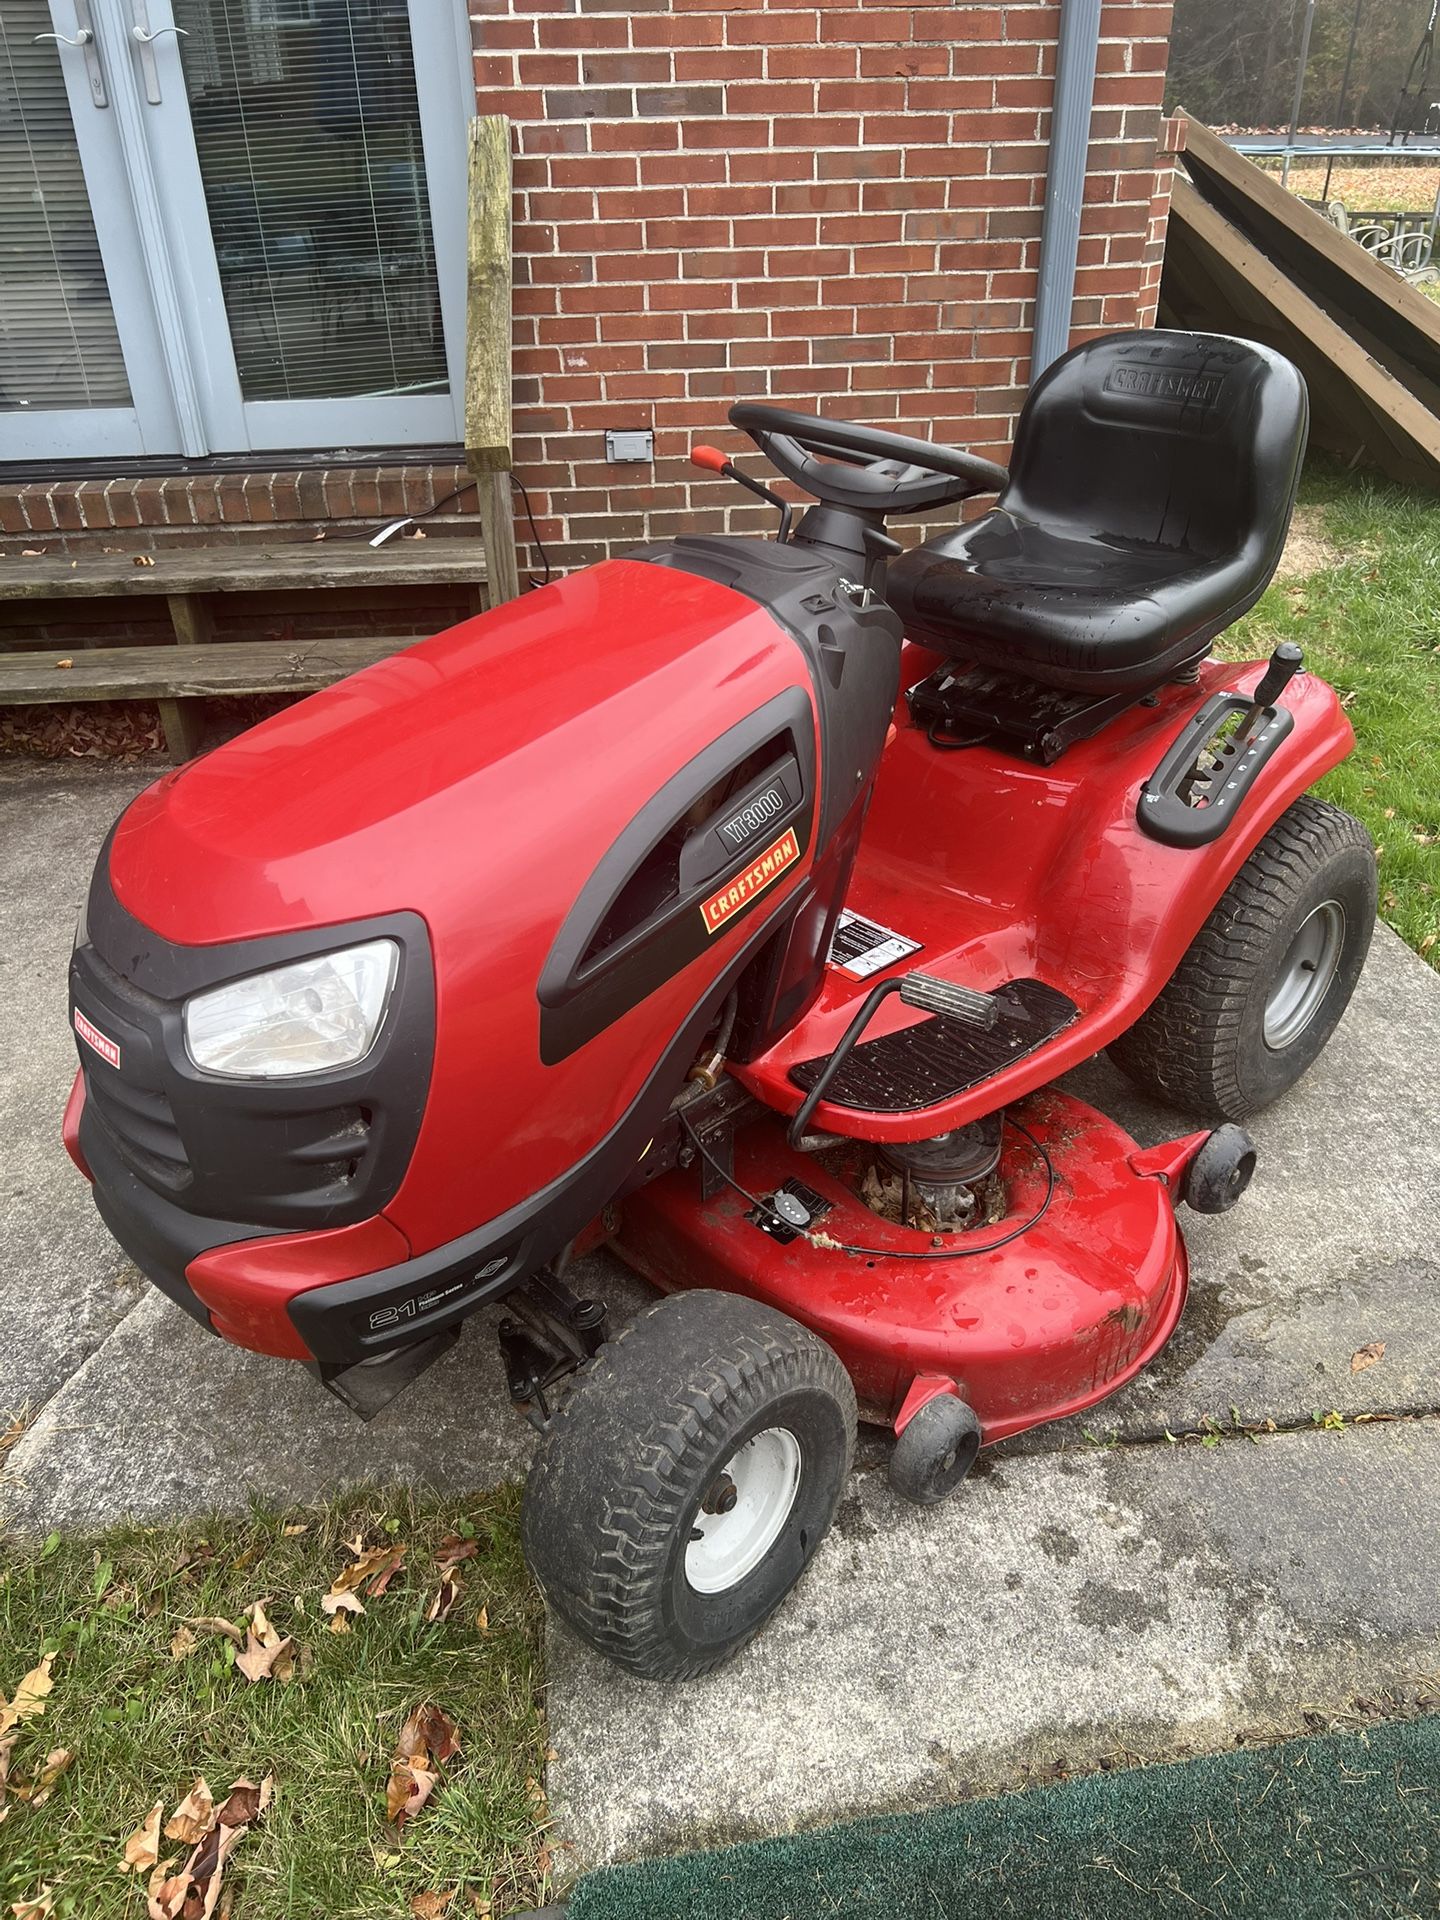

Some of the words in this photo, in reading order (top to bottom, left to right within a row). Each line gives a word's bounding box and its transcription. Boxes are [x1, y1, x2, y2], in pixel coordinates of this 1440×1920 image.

[1114, 368, 1217, 400] CRAFTSMAN
[723, 815, 750, 844] YT
[744, 789, 783, 830] 3000
[709, 840, 793, 920] CRAFTSMAN
[77, 1016, 117, 1061] CRAFTSMAN
[445, 1283, 463, 1295] Series
[369, 1298, 416, 1330] 21
